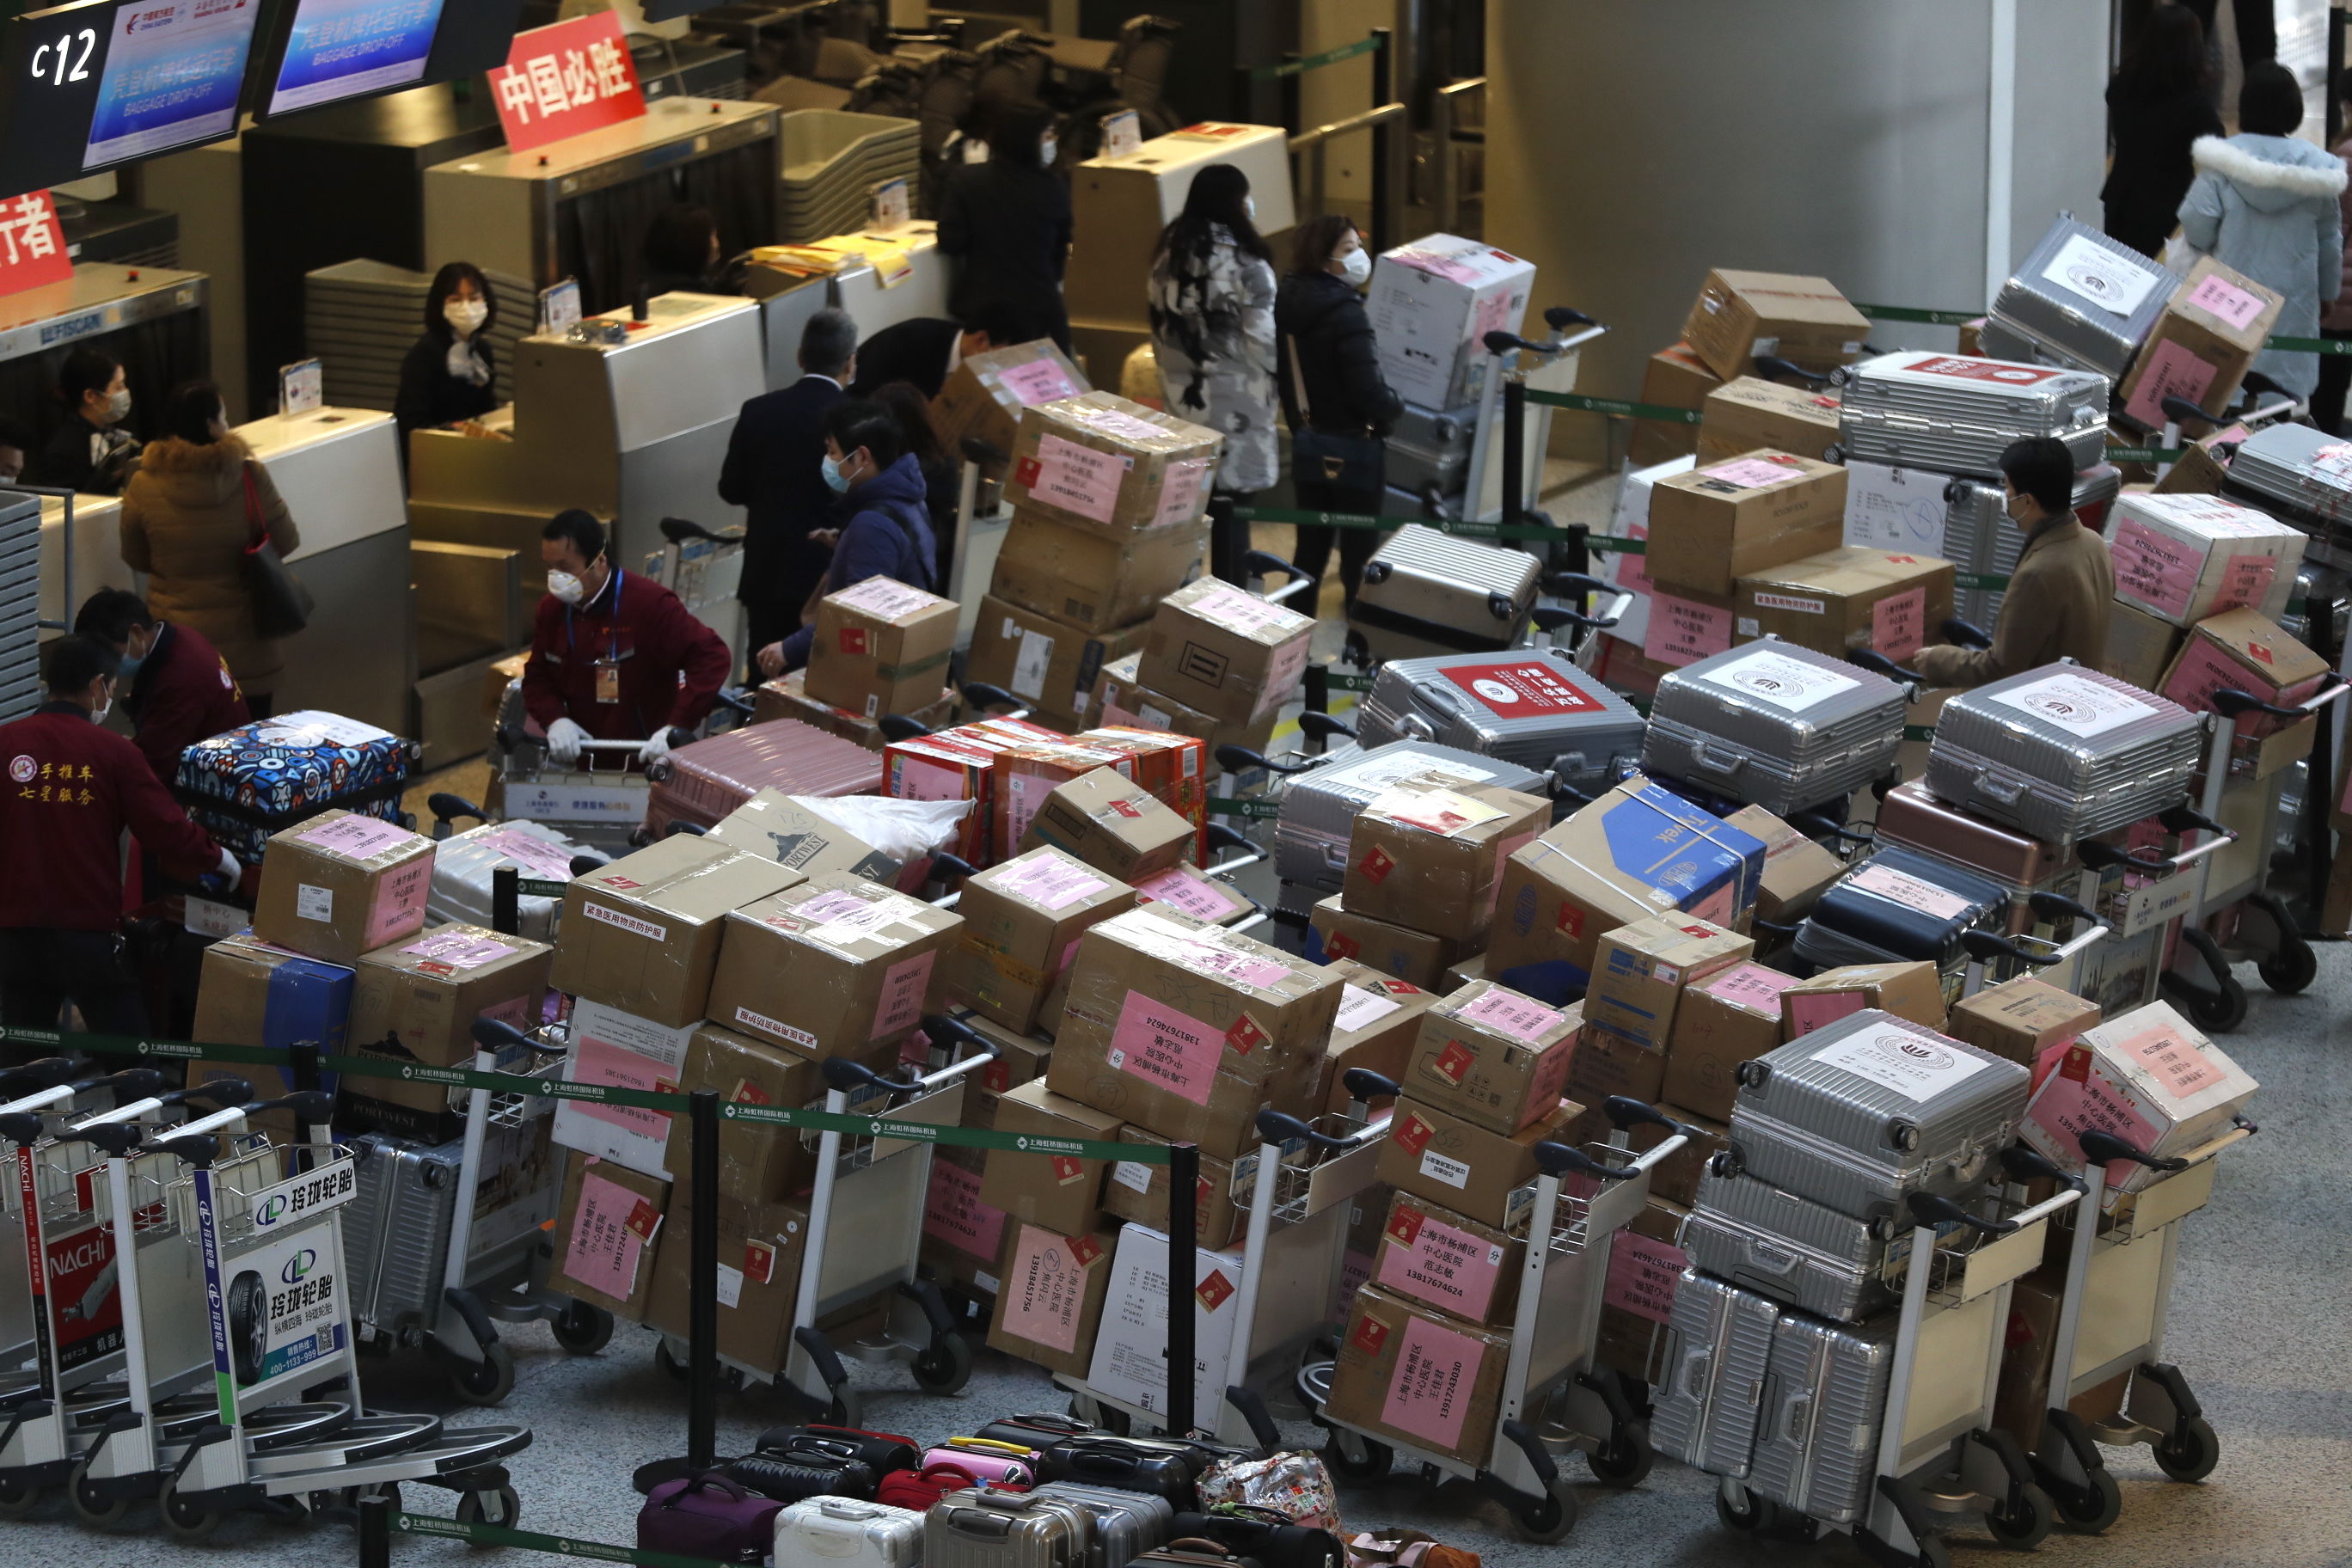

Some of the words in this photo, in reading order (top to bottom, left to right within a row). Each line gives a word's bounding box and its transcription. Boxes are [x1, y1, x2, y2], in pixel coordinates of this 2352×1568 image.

[312, 45, 357, 67] BAGGAGE
[357, 33, 407, 56] DROP-OFF
[499, 36, 633, 126] 中国必胜
[123, 93, 166, 118] BAGGAGE
[167, 82, 213, 107] DROP-OFF
[40, 763, 95, 783] 手推车
[18, 786, 95, 805] 七星服务
[586, 904, 663, 939] 紧急医用物资防护服
[739, 1009, 816, 1046] 紧急医用物资防护服
[1147, 1016, 1200, 1046] 13817674624
[150, 1044, 203, 1055] 上海虹桥国际机场
[1145, 1045, 1184, 1070] 中心医院
[414, 1069, 465, 1081] 上海虹桥国际机场
[1132, 1055, 1191, 1087] 上海市杨浦区
[554, 1083, 605, 1096] 上海虹桥国际机场
[353, 1102, 417, 1128] PORTWEST
[737, 1106, 791, 1119] 上海虹桥国际机场
[2081, 1099, 2116, 1134] 中心医院
[882, 1122, 937, 1136] 上海虹桥国际机场
[1029, 1138, 1083, 1151] 上海虹桥国际机场
[291, 1167, 353, 1213] 玲珑轮胎
[577, 1198, 597, 1259] 上海市杨浦区
[591, 1213, 607, 1253] 中心医院
[1418, 1226, 1479, 1258] 上海市杨浦区
[1423, 1244, 1464, 1268] 中心医院
[1424, 1259, 1455, 1279] 范志敏
[1489, 1251, 1500, 1262] 分
[270, 1275, 333, 1320] 玲珑轮胎
[1023, 1253, 1040, 1313] 13918451756
[1049, 1272, 1066, 1314] 中心医院
[1061, 1266, 1081, 1328] 上海市杨浦区
[1406, 1269, 1463, 1297] 13817674624
[274, 1314, 303, 1335] 纵横四海
[305, 1303, 333, 1322] 玲珑轮胎
[270, 1350, 316, 1375] 400-1133-999
[1397, 1344, 1423, 1406] 上海市杨浦区
[1413, 1359, 1433, 1400] 中心医院
[1429, 1369, 1445, 1401] 王佳君
[1440, 1361, 1462, 1419] 13917243030
[413, 1518, 471, 1534] 上海虹桥国际机场
